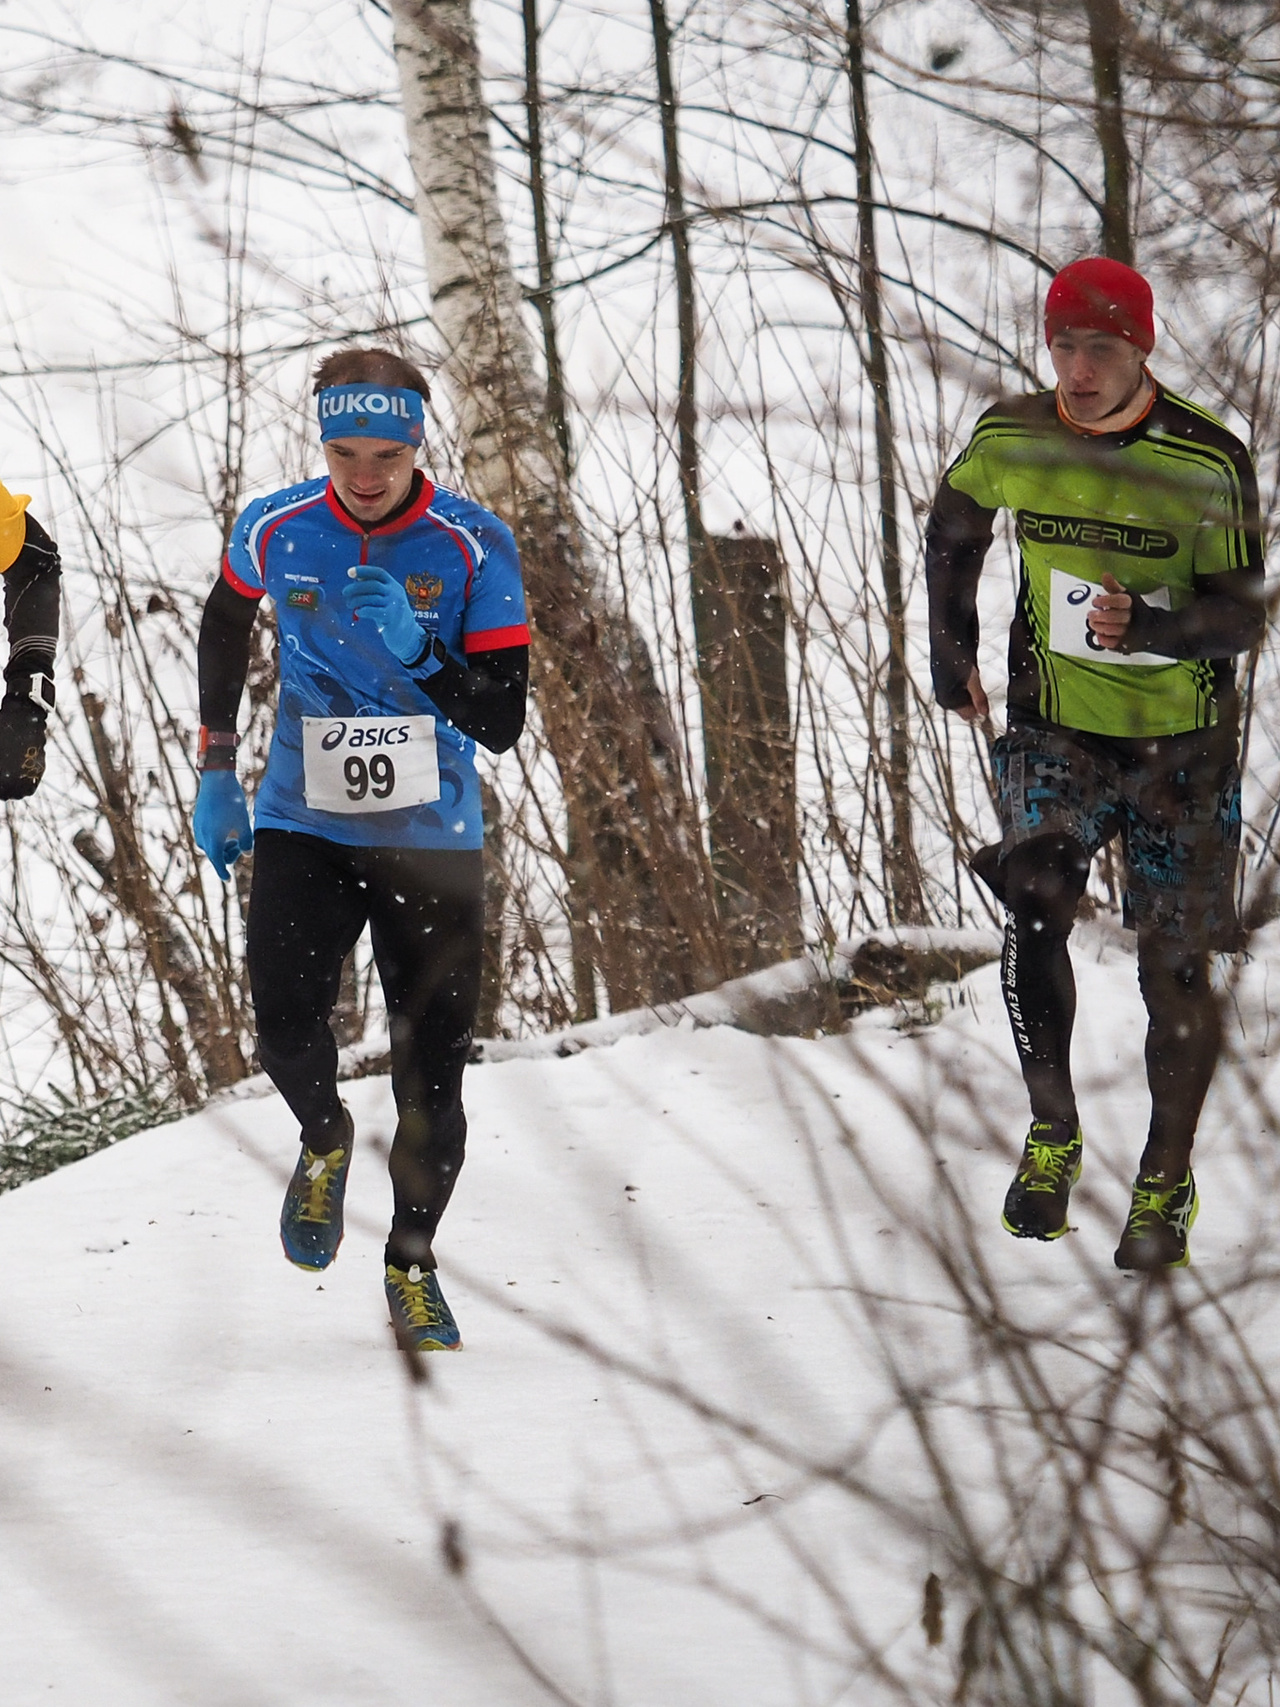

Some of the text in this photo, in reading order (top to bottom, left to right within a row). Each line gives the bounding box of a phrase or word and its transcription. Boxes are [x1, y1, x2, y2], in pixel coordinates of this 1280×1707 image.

[1023, 515, 1168, 551] POWERUP
[343, 753, 395, 801] 99
[1006, 931, 1017, 988] STRNGR
[1007, 991, 1026, 1031] EVRY
